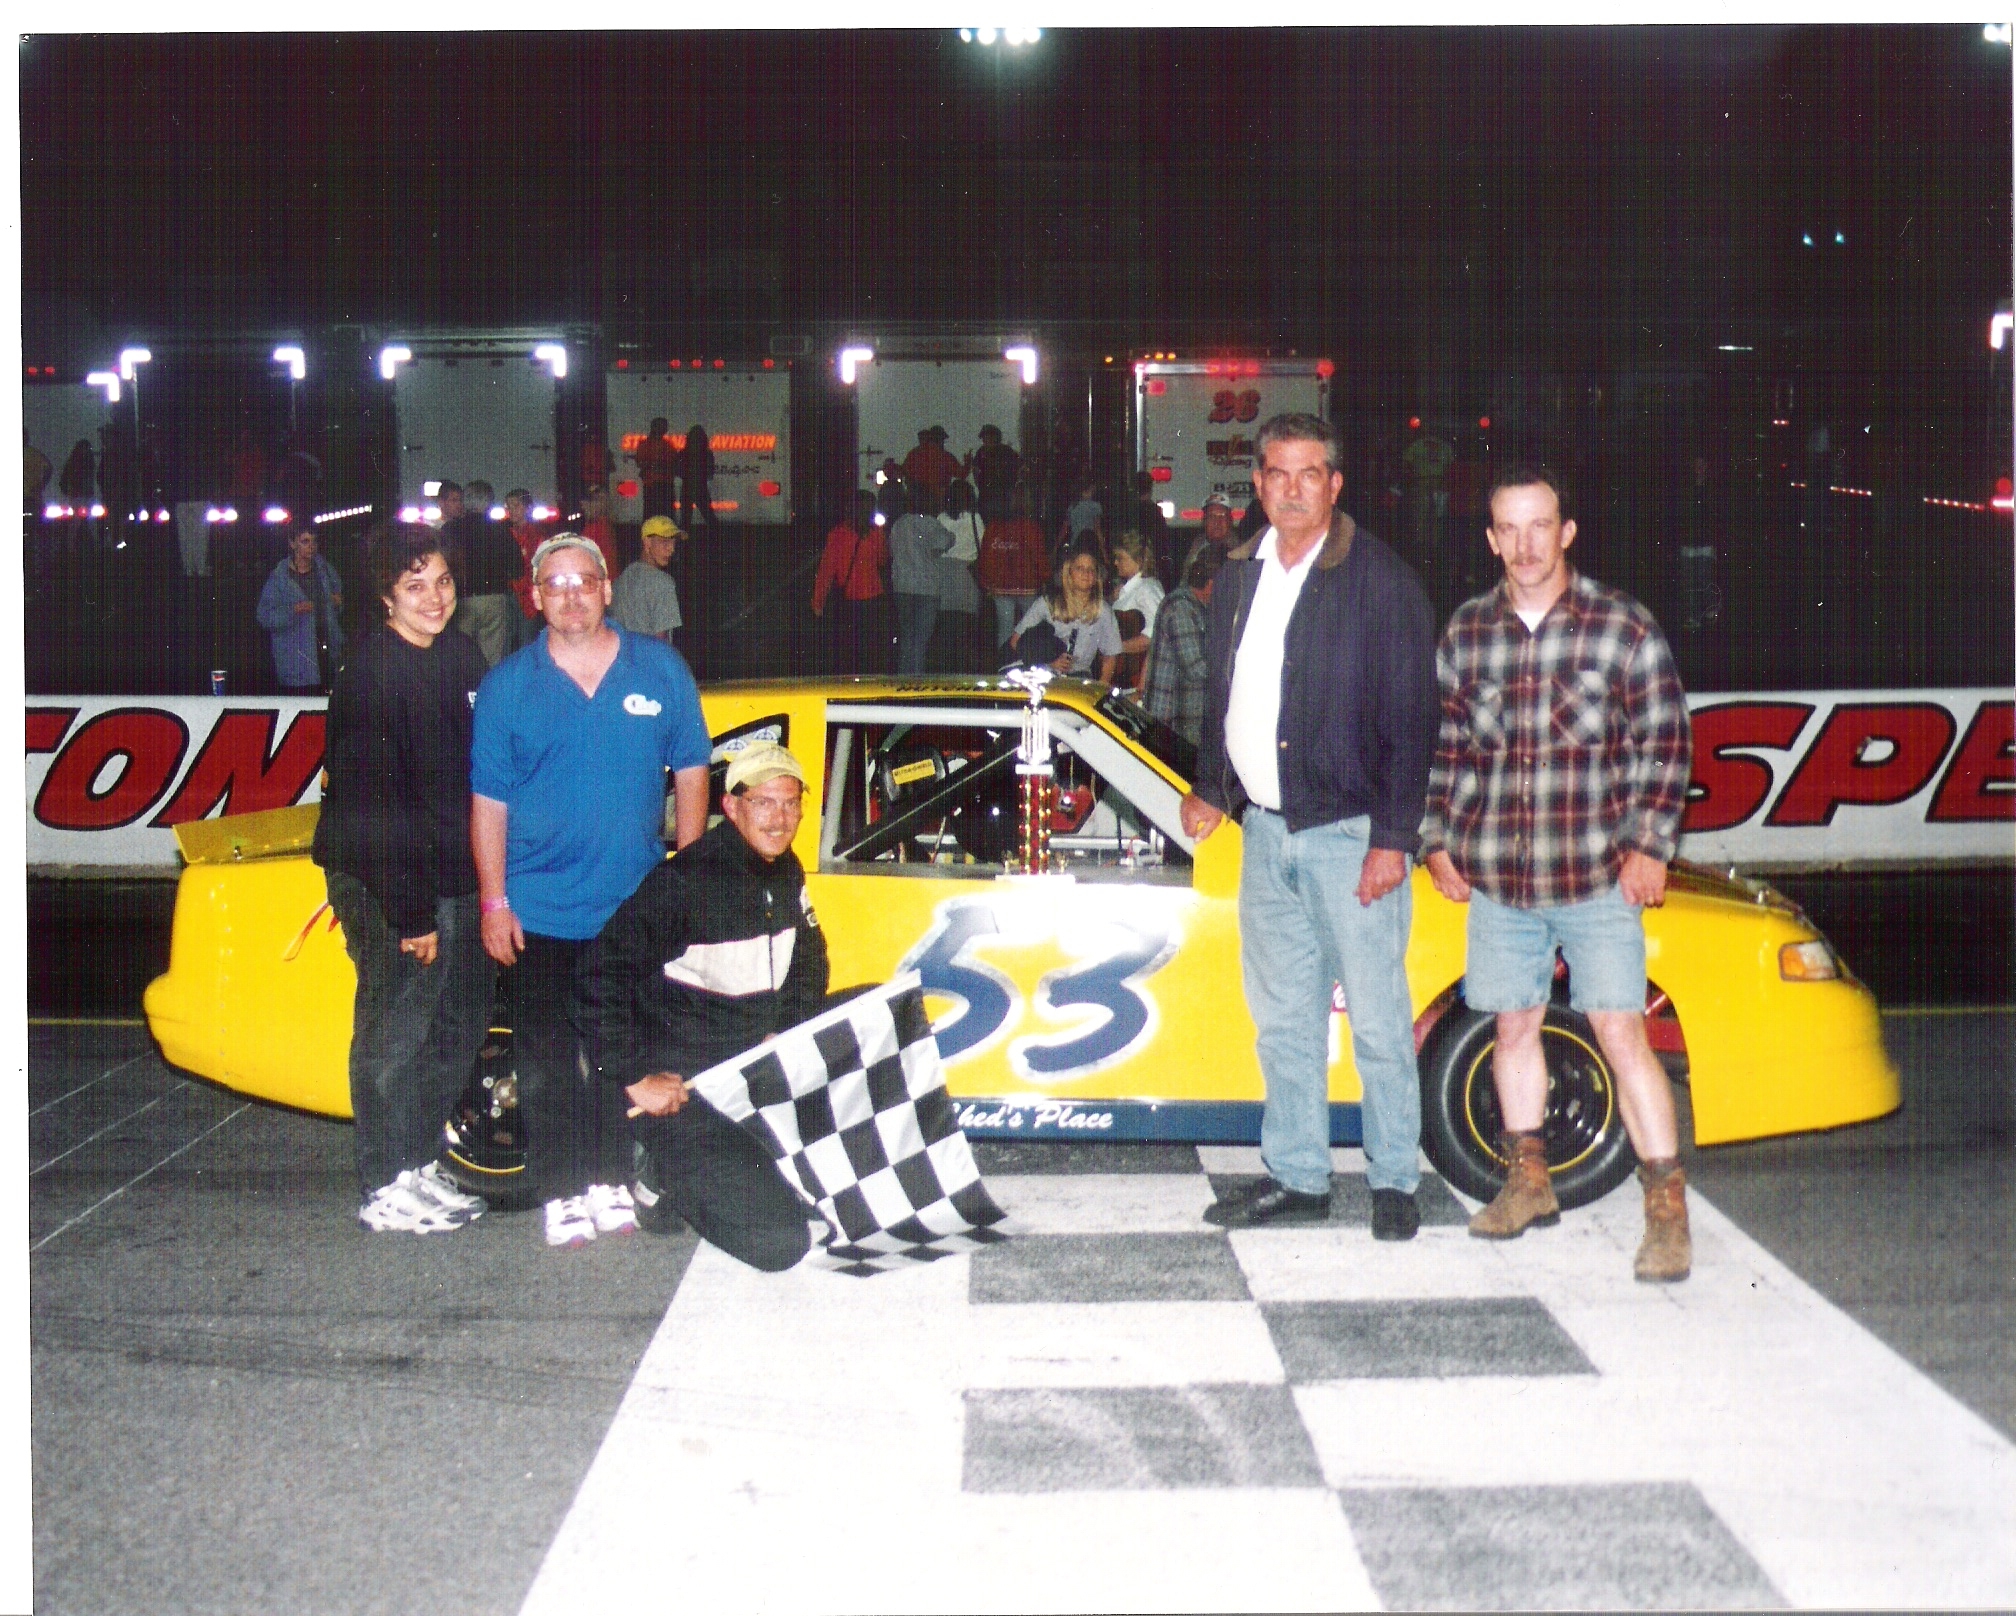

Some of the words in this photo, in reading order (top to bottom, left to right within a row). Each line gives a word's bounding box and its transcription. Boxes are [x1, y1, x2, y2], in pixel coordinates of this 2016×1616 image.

[710, 434, 777, 451] AVIATION
[896, 898, 1180, 1083] 53
[952, 1102, 1024, 1129] hed's
[1033, 1103, 1114, 1129] Place
